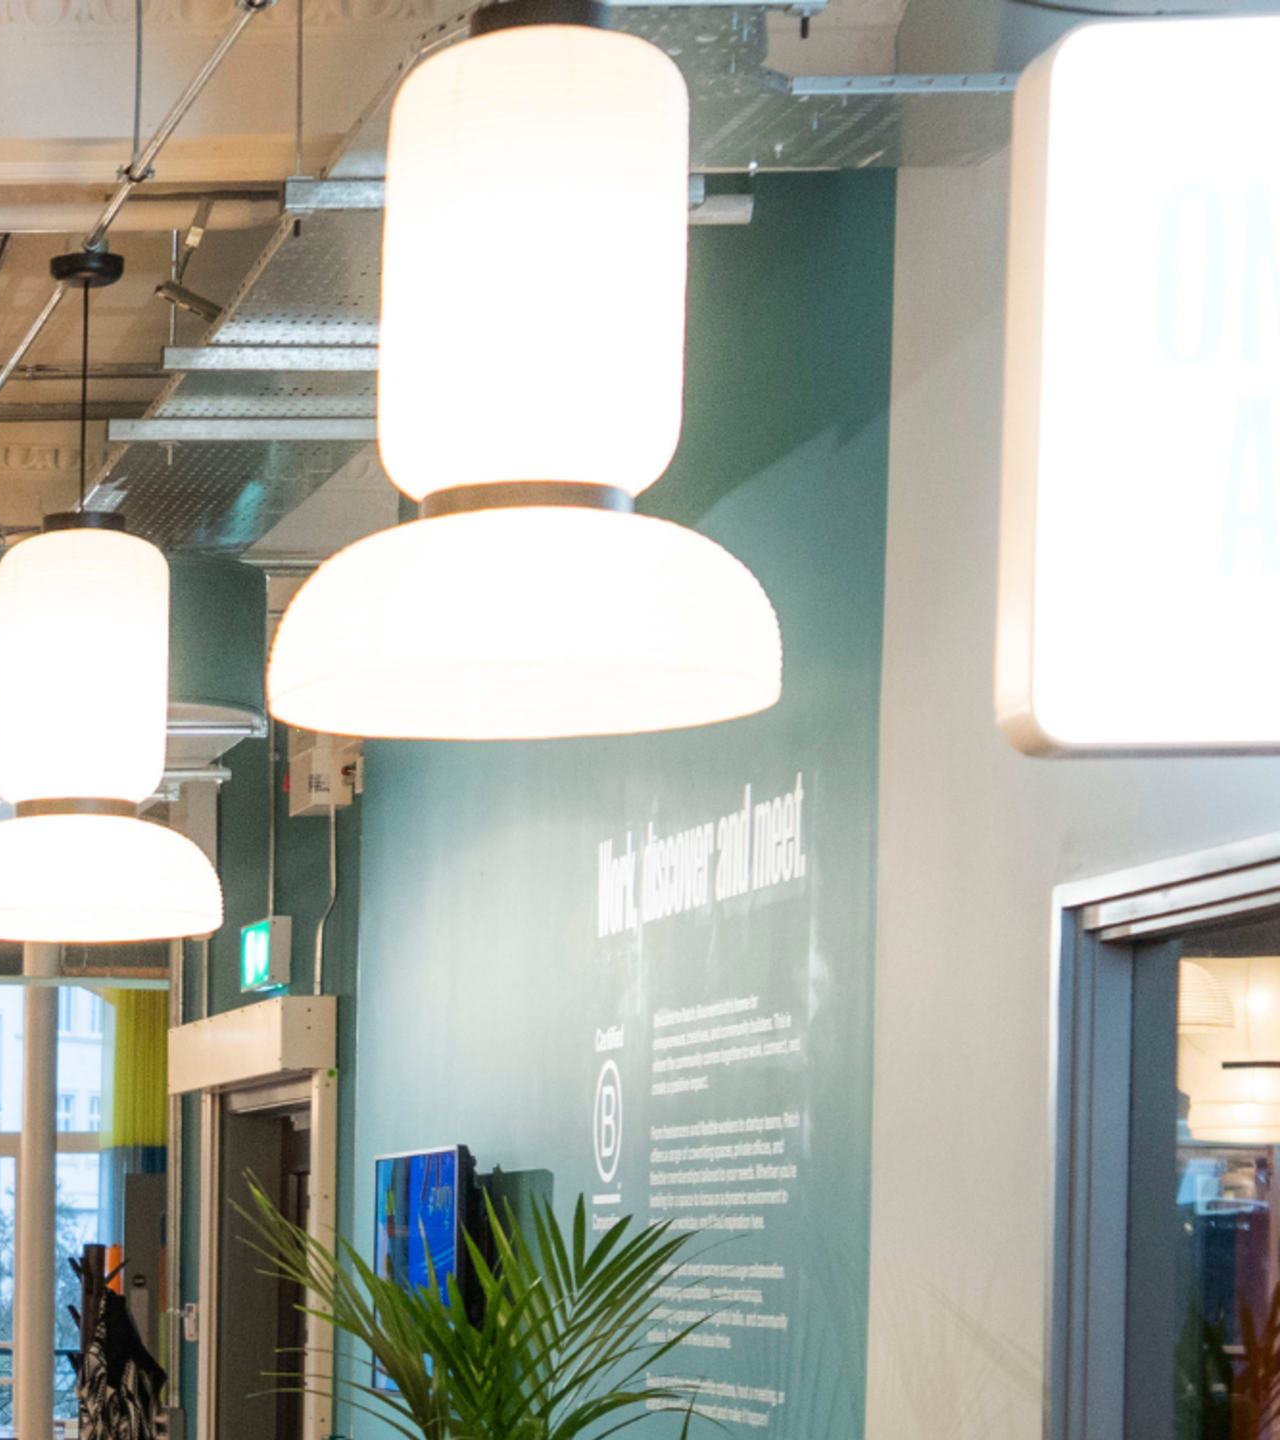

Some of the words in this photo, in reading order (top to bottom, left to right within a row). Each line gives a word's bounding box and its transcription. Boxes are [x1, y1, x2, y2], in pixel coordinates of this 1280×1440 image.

[597, 831, 638, 938] Work,
[642, 821, 714, 924] discover
[714, 783, 751, 901] and
[752, 771, 806, 891] meet.
